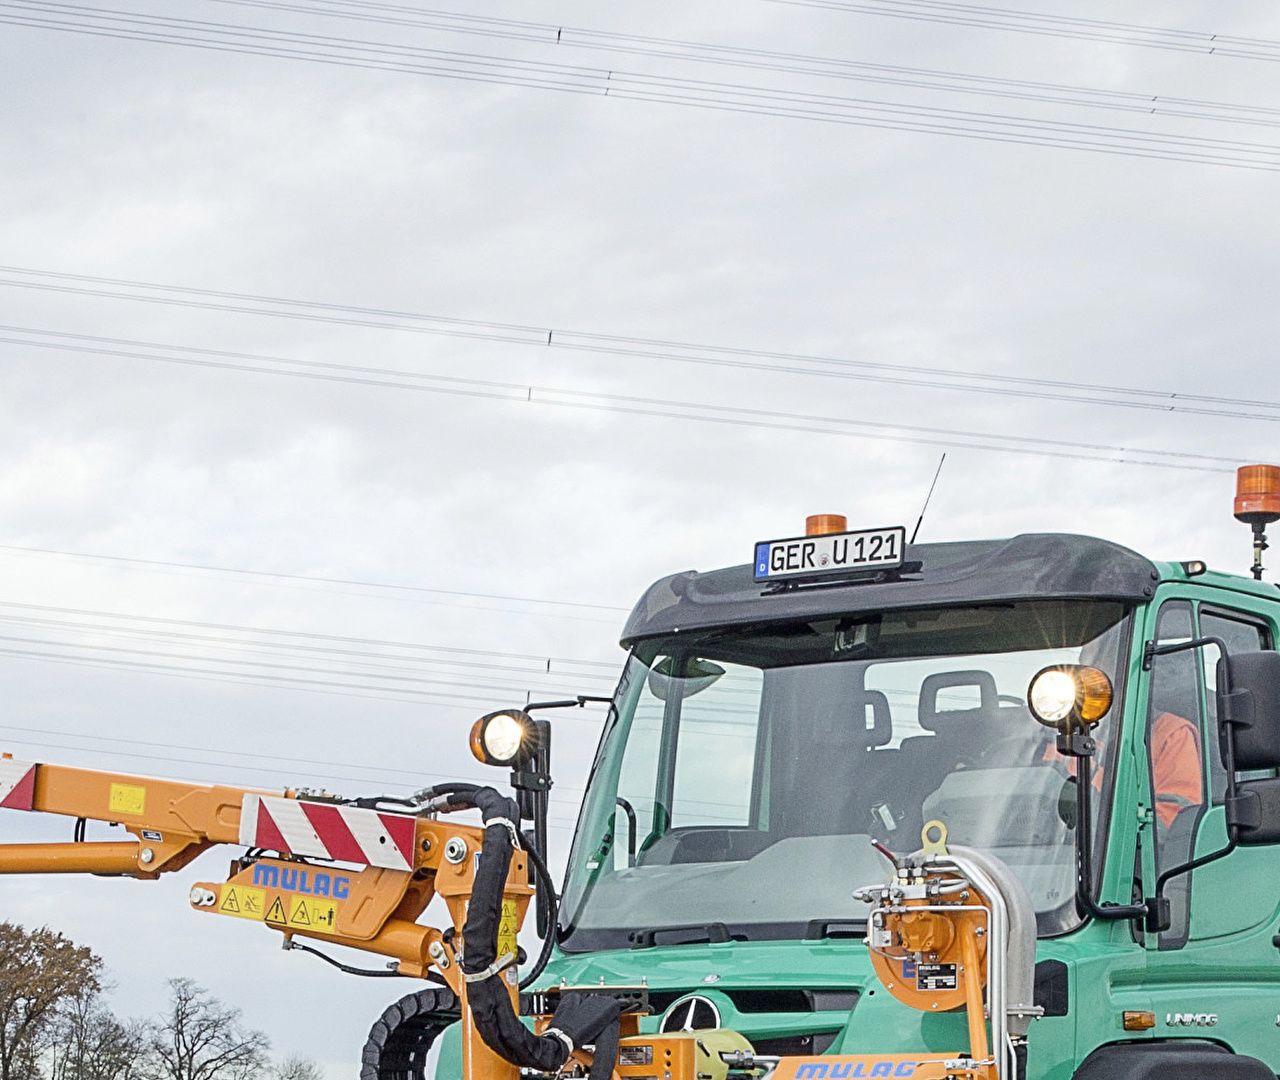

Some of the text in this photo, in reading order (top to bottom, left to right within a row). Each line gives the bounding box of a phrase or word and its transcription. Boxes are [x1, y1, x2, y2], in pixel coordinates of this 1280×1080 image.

[770, 533, 898, 572] GER U 121
[252, 863, 350, 900] MULAG
[1166, 1012, 1218, 1028] UNIMOG
[794, 1061, 918, 1080] MULAG
